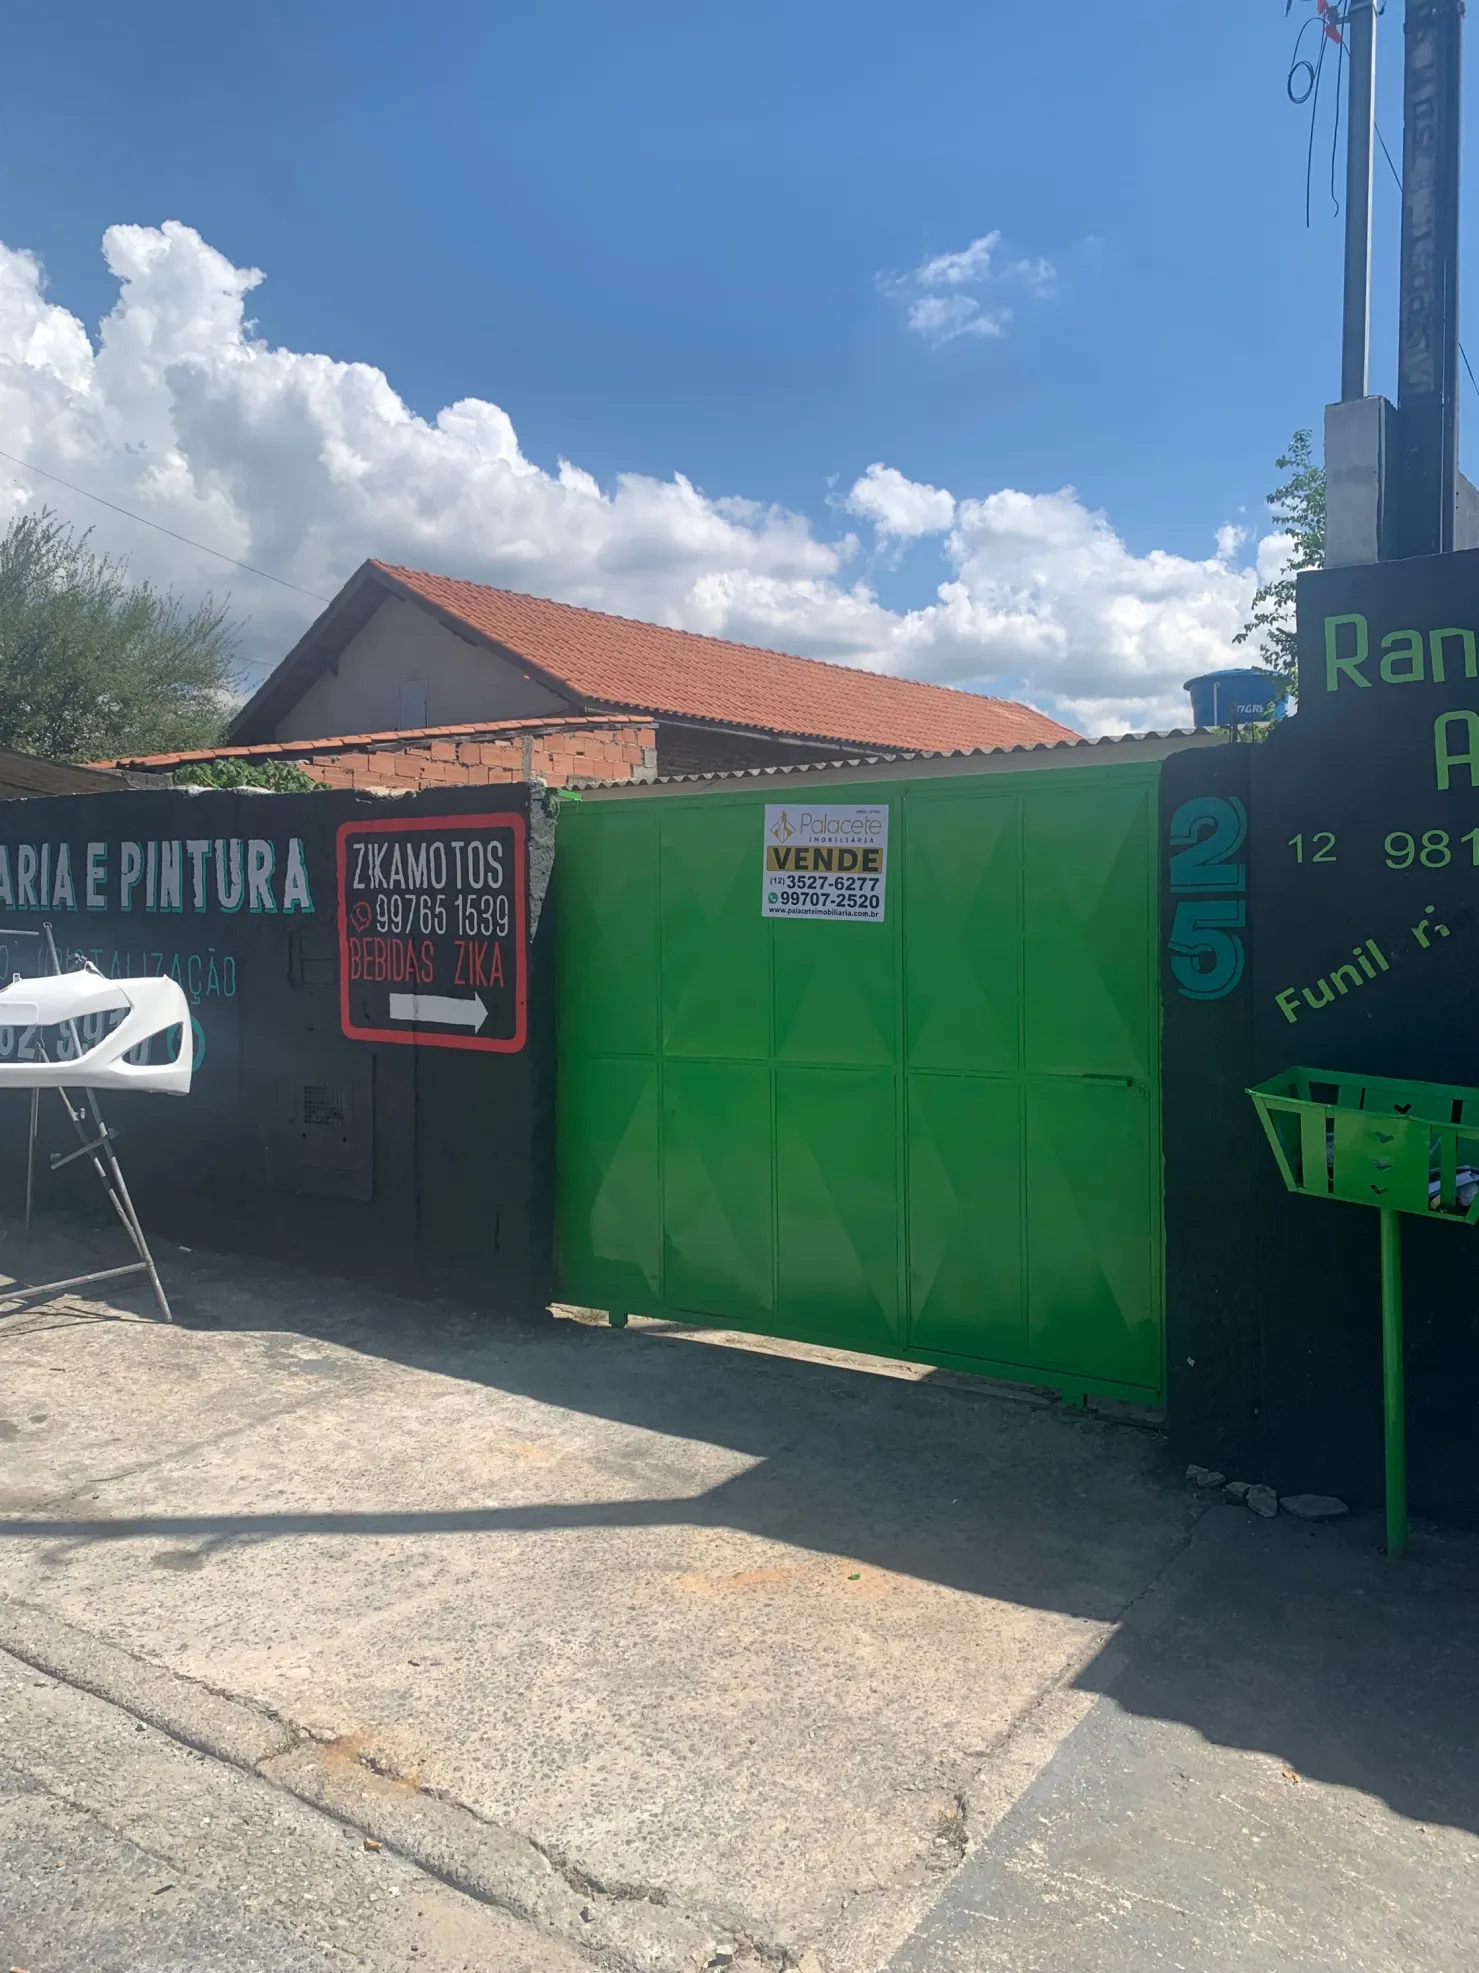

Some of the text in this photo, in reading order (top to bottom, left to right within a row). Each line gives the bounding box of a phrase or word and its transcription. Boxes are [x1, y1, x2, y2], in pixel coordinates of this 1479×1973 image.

[1324, 612, 1478, 692] Ran
[1434, 709, 1479, 791] A
[800, 812, 882, 835] Palacete
[772, 847, 880, 872] VENDE
[1288, 827, 1479, 870] 12 981
[86, 842, 108, 912] E
[119, 837, 316, 914] PINTURA
[769, 874, 880, 891] (12) 3527-6277
[376, 894, 509, 937] 99765 1539
[768, 907, 879, 918] www.palaceteimobiliaria.com.br
[780, 891, 880, 909] 99707-2520
[350, 936, 505, 988] BEBIDAS ZIKA
